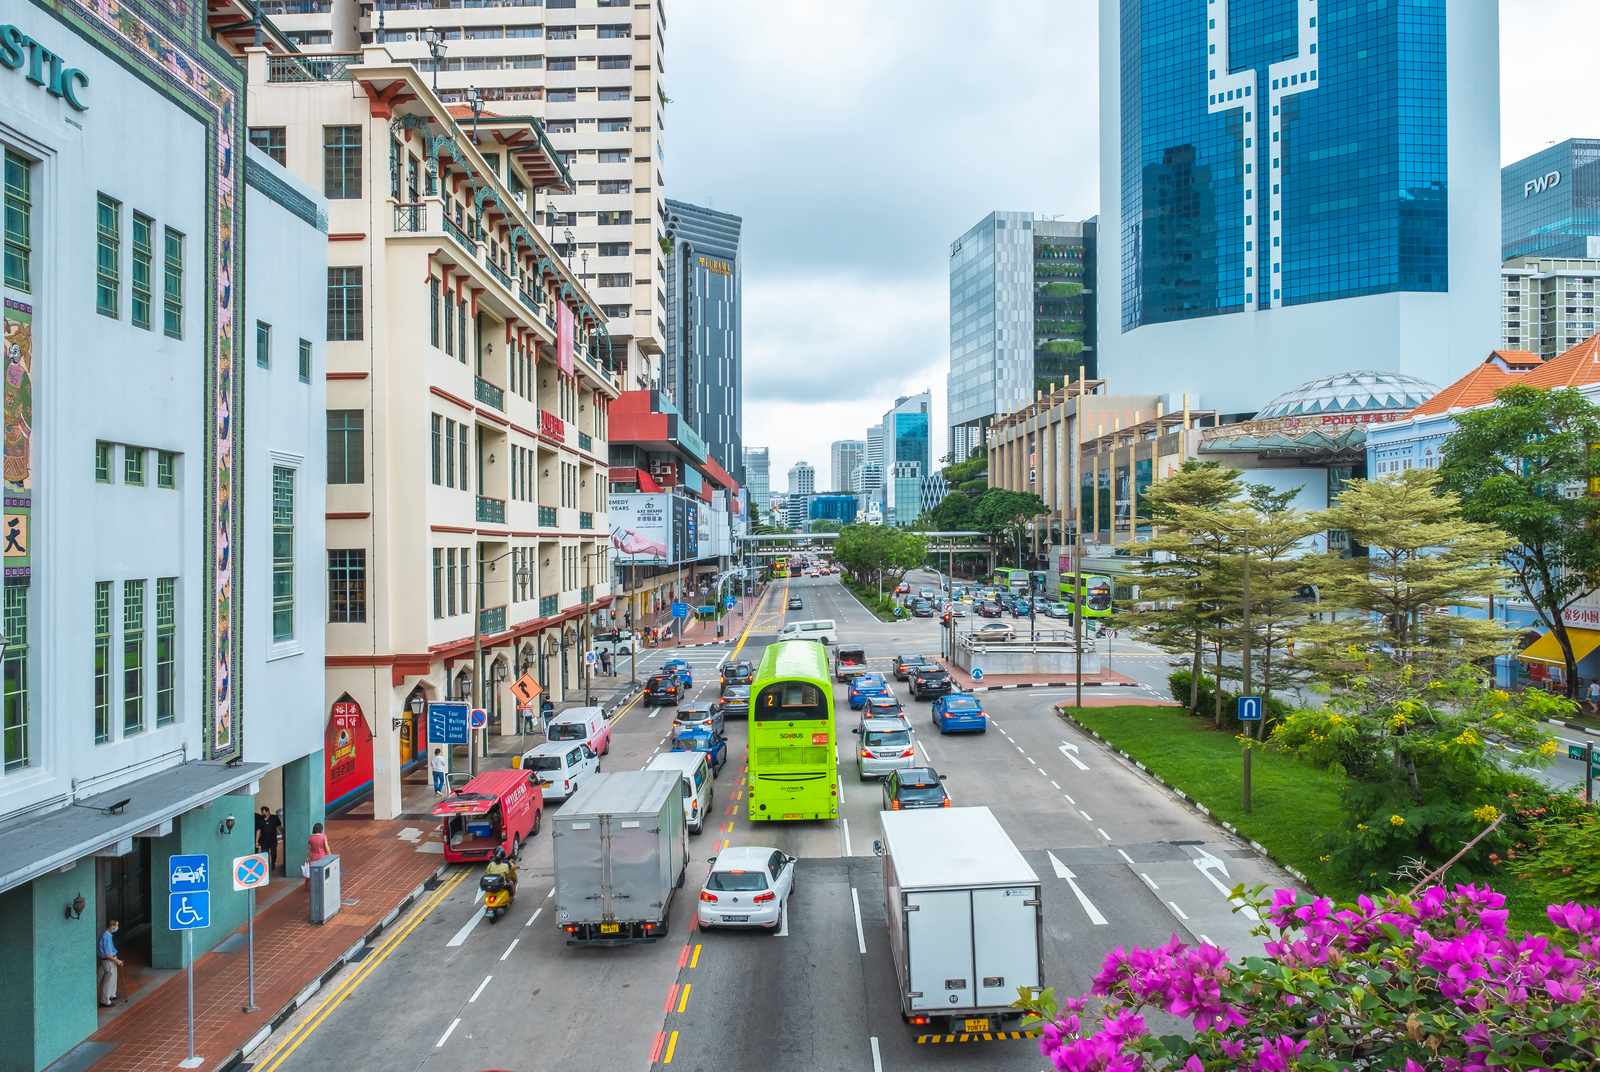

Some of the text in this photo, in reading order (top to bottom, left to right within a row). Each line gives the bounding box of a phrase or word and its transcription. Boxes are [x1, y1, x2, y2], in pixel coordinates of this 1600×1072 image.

[0, 24, 89, 112] STIC
[1524, 170, 1562, 199] FWD
[767, 695, 773, 707] 2
